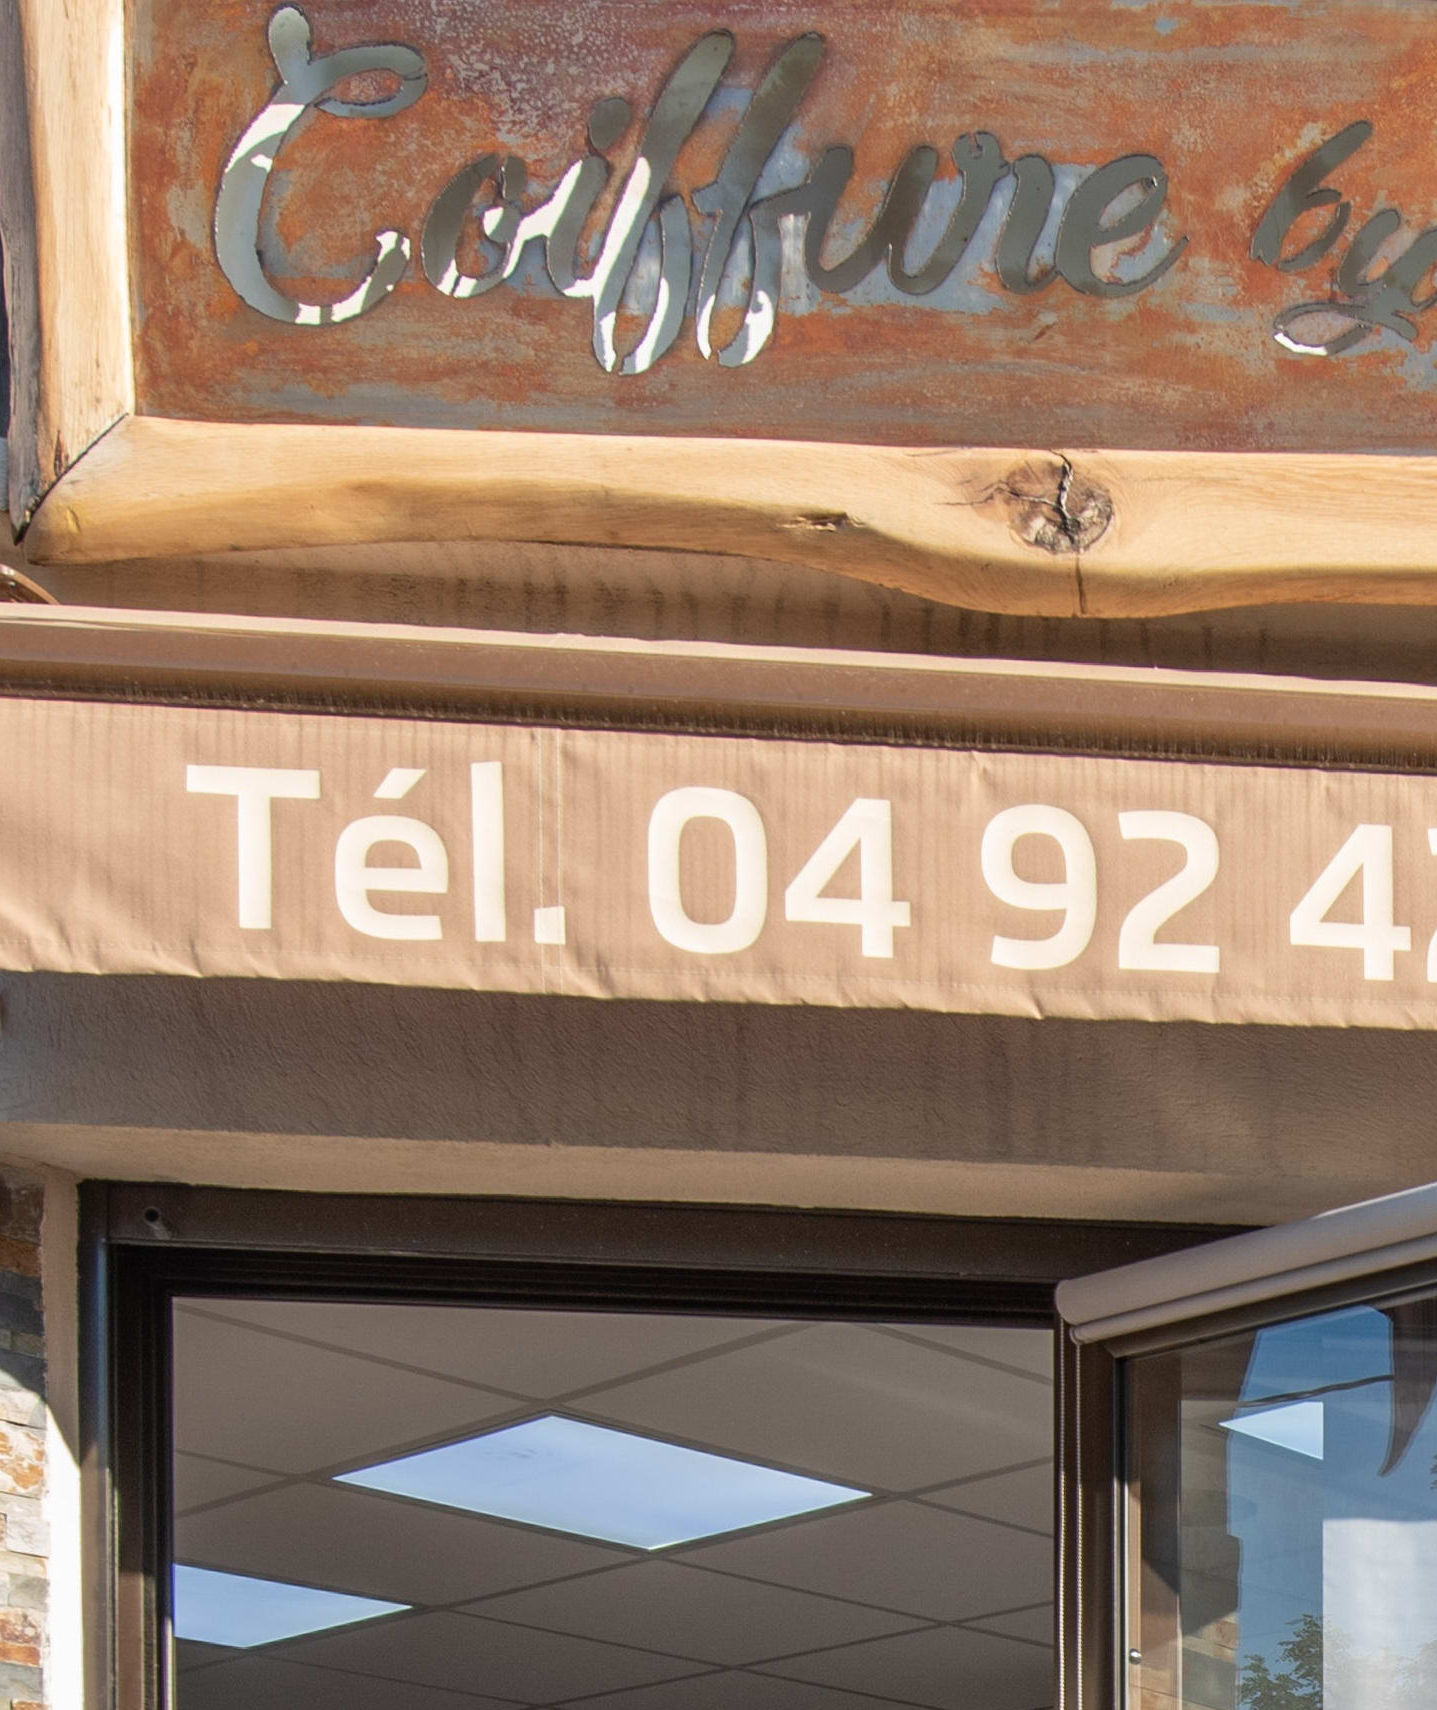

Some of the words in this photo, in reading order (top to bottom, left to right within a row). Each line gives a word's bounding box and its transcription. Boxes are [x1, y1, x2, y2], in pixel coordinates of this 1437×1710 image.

[212, 4, 1187, 380] Coiffure
[183, 756, 569, 951] Tél.
[642, 782, 915, 963] 04
[980, 800, 1223, 975] 92
